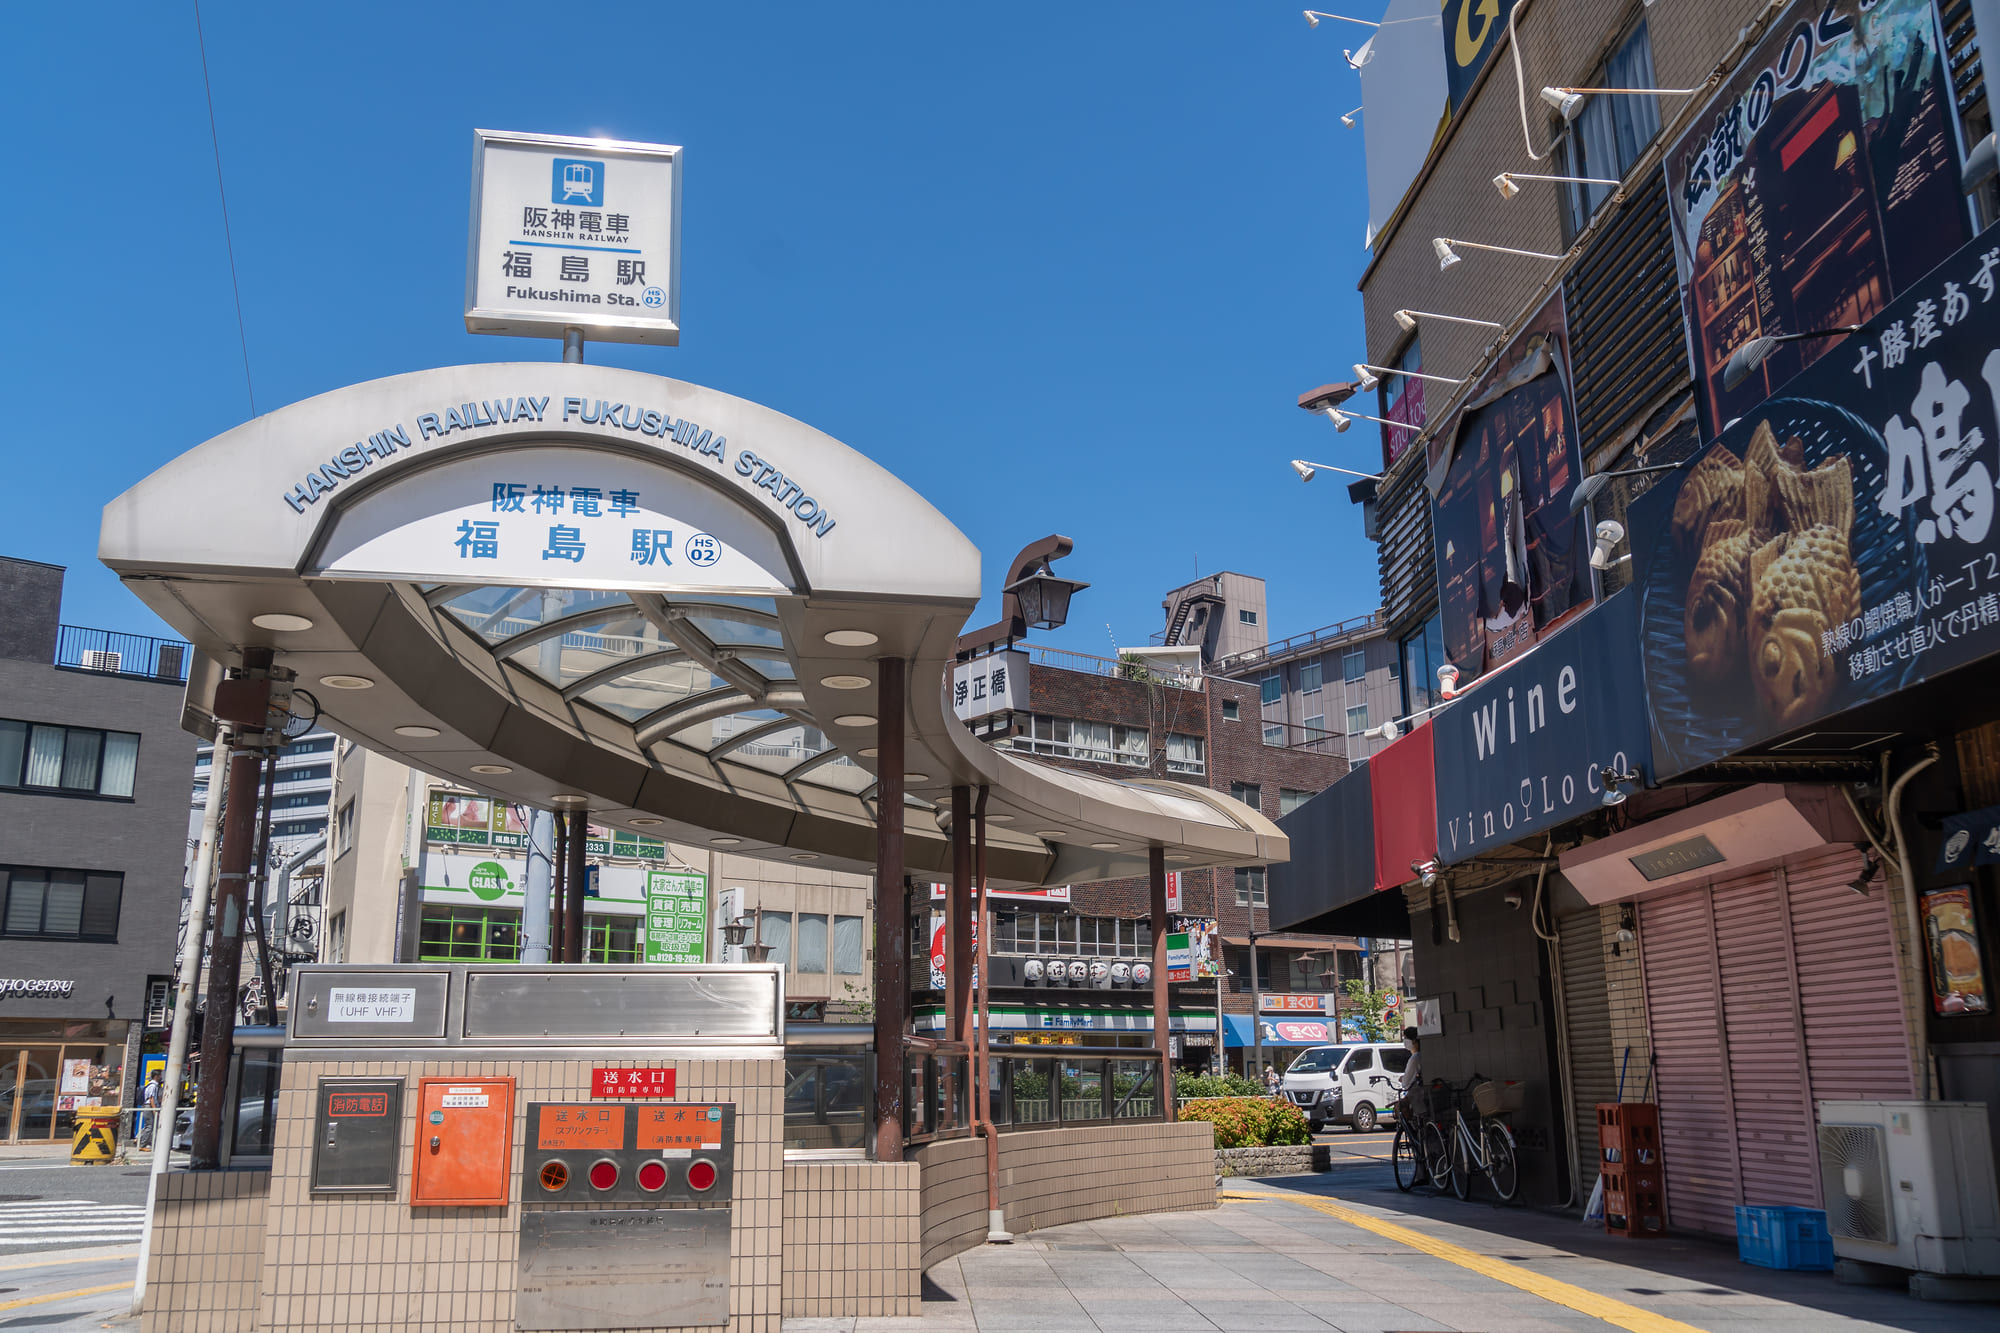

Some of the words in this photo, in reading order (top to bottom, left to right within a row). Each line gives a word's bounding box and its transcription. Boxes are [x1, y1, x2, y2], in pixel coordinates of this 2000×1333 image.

[523, 206, 630, 235] 阪神電車
[522, 229, 574, 240] HANSHIN
[579, 233, 629, 244] RAILWAY
[502, 250, 646, 286] 福島駅
[506, 286, 601, 304] Fukushima
[607, 293, 640, 307] Sta.
[645, 296, 662, 305] 02
[284, 424, 411, 513] HANSHIN
[417, 396, 550, 440] RAILWAY
[562, 397, 728, 463] FUKUSHIMA
[734, 450, 836, 538] STATION
[492, 482, 640, 519] 阪神電車
[454, 518, 674, 567] 福島駅
[695, 538, 714, 549] HS
[690, 549, 716, 562] 02
[1847, 590, 2000, 681] 移動させ直火で丹精
[1472, 665, 1577, 761] Wine
[1448, 802, 1515, 853] Vino
[334, 993, 412, 1004] 無線機接続端子
[1385, 995, 1397, 1004] 50
[1055, 1016, 1094, 1028] FamilyMart
[603, 1071, 665, 1085] 送水口
[332, 1098, 384, 1113] 消防電話
[555, 1109, 611, 1122] 送水口
[653, 1109, 707, 1122] 送水口
